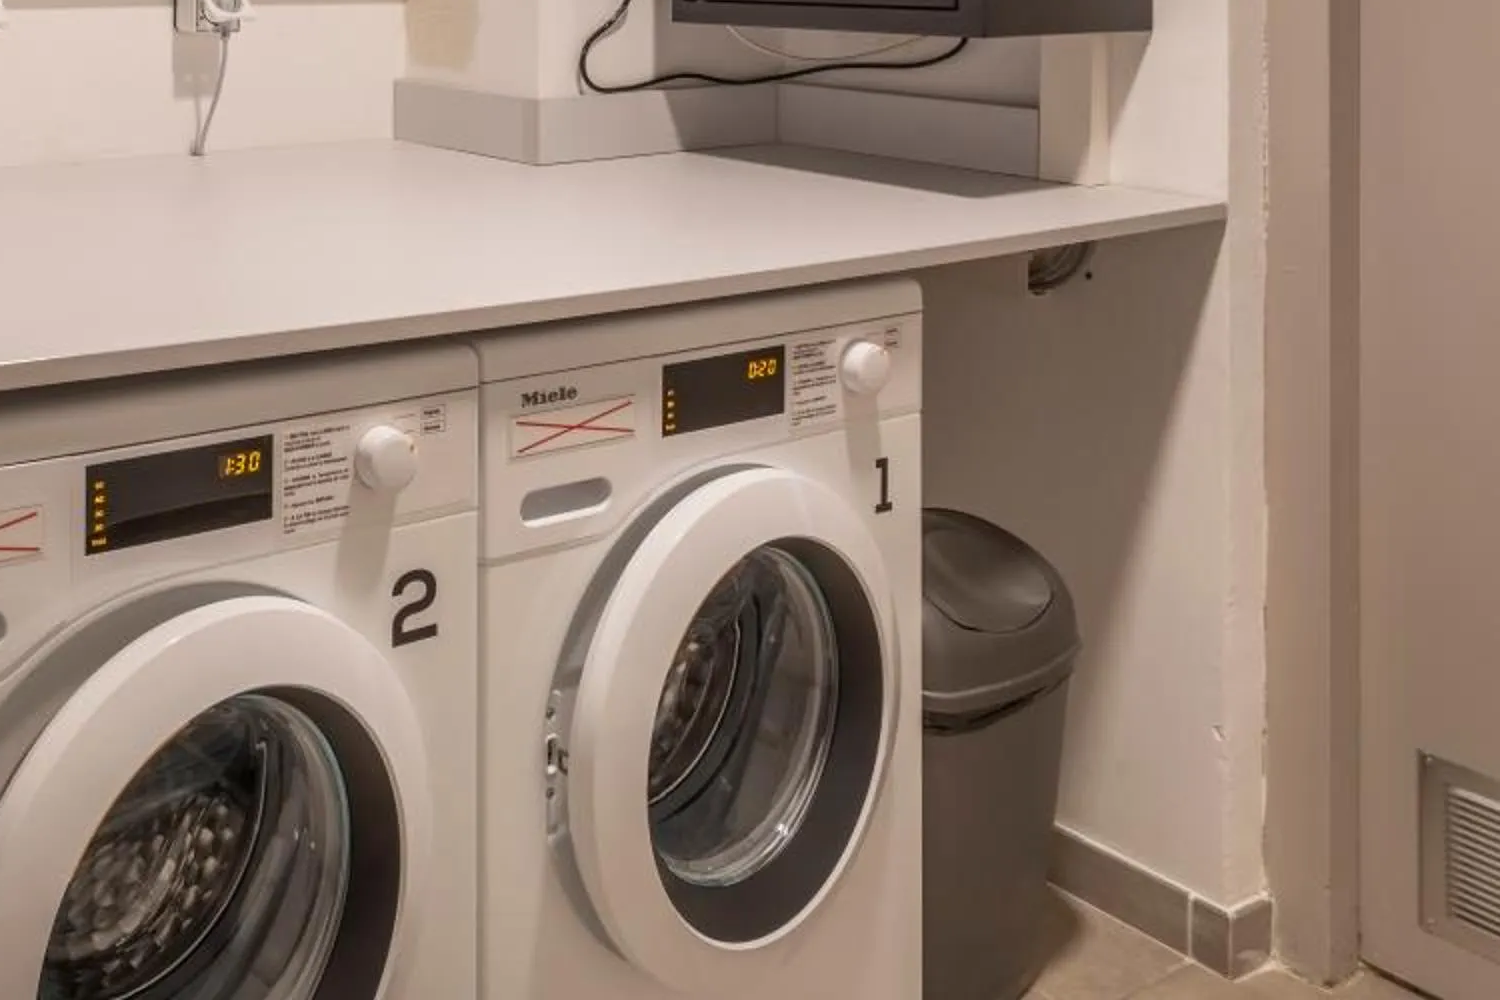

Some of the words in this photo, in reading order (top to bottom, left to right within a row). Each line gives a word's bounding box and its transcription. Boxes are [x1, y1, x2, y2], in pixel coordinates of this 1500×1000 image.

[520, 385, 578, 408] Miele
[224, 451, 261, 476] 1:30
[875, 457, 893, 514] 1
[391, 568, 438, 649] 2
